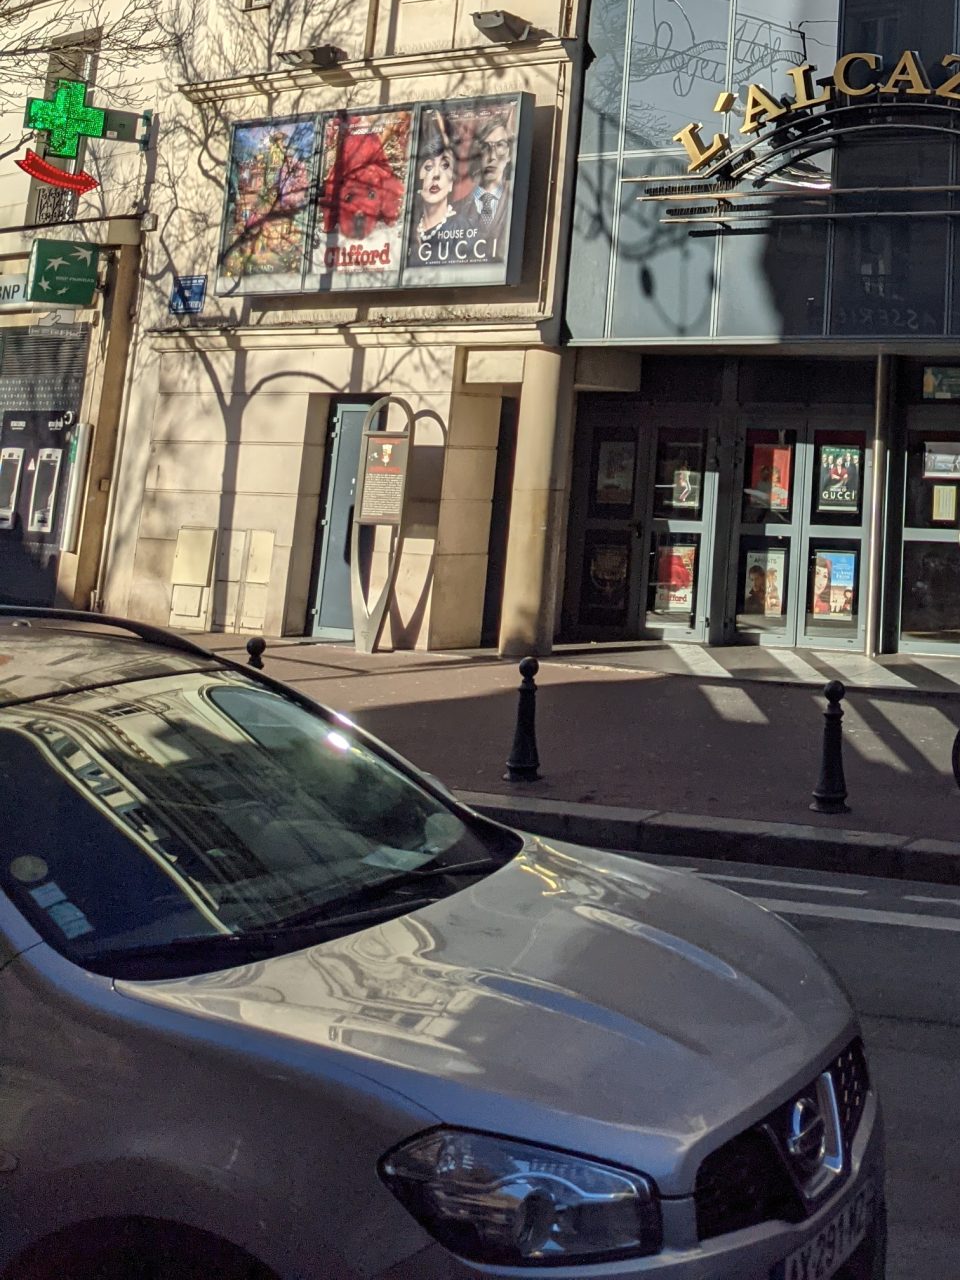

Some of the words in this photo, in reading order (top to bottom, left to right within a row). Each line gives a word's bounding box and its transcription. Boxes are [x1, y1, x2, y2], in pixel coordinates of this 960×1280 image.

[437, 229, 465, 240] HOUSE
[466, 228, 479, 239] OF
[324, 242, 392, 268] Clifford
[418, 238, 498, 262] GUCCI
[822, 490, 855, 500] GUCCI
